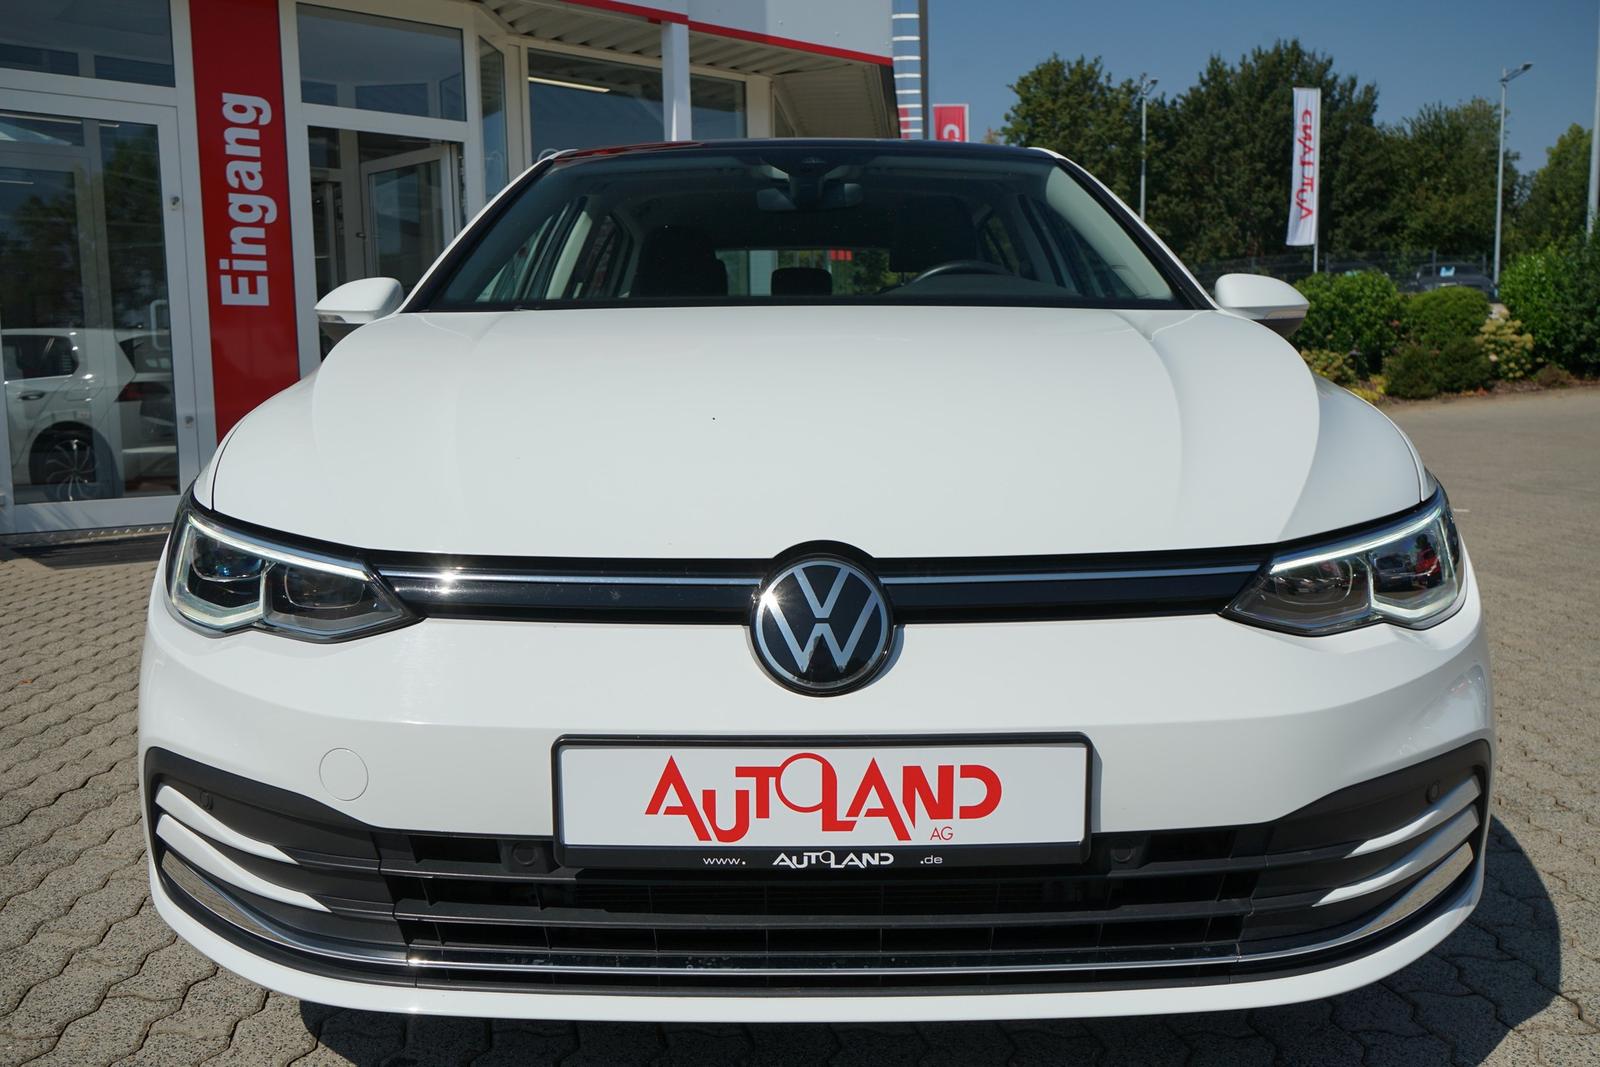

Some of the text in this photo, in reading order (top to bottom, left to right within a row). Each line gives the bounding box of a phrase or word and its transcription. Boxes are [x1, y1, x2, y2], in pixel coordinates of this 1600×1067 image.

[219, 92, 277, 306] Eingang
[645, 752, 1002, 843] AUTOLAND
[703, 850, 943, 869] www. AUTOLAND .de
[929, 826, 953, 841] AG
